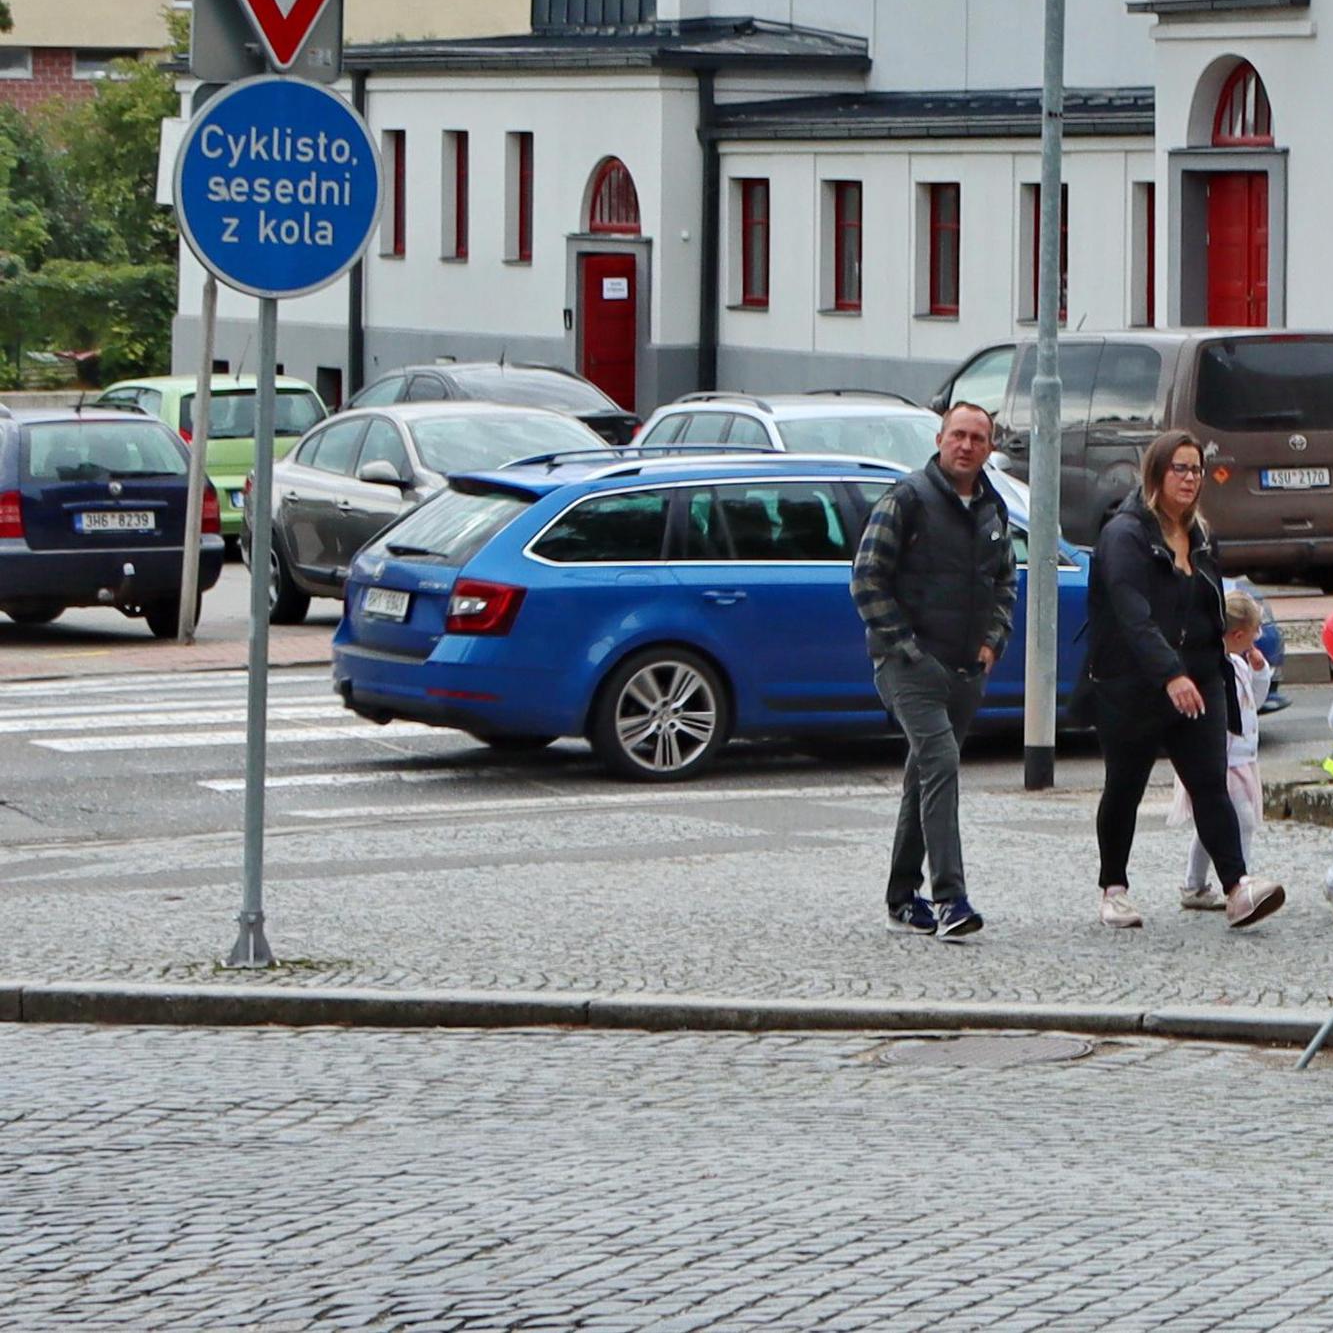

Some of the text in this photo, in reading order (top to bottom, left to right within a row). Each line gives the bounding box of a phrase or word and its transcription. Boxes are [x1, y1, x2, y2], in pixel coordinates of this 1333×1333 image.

[200, 123, 359, 168] Cyklisto,
[206, 171, 351, 206] sesedni
[220, 209, 334, 246] z kola
[1299, 469, 1325, 484] 2170
